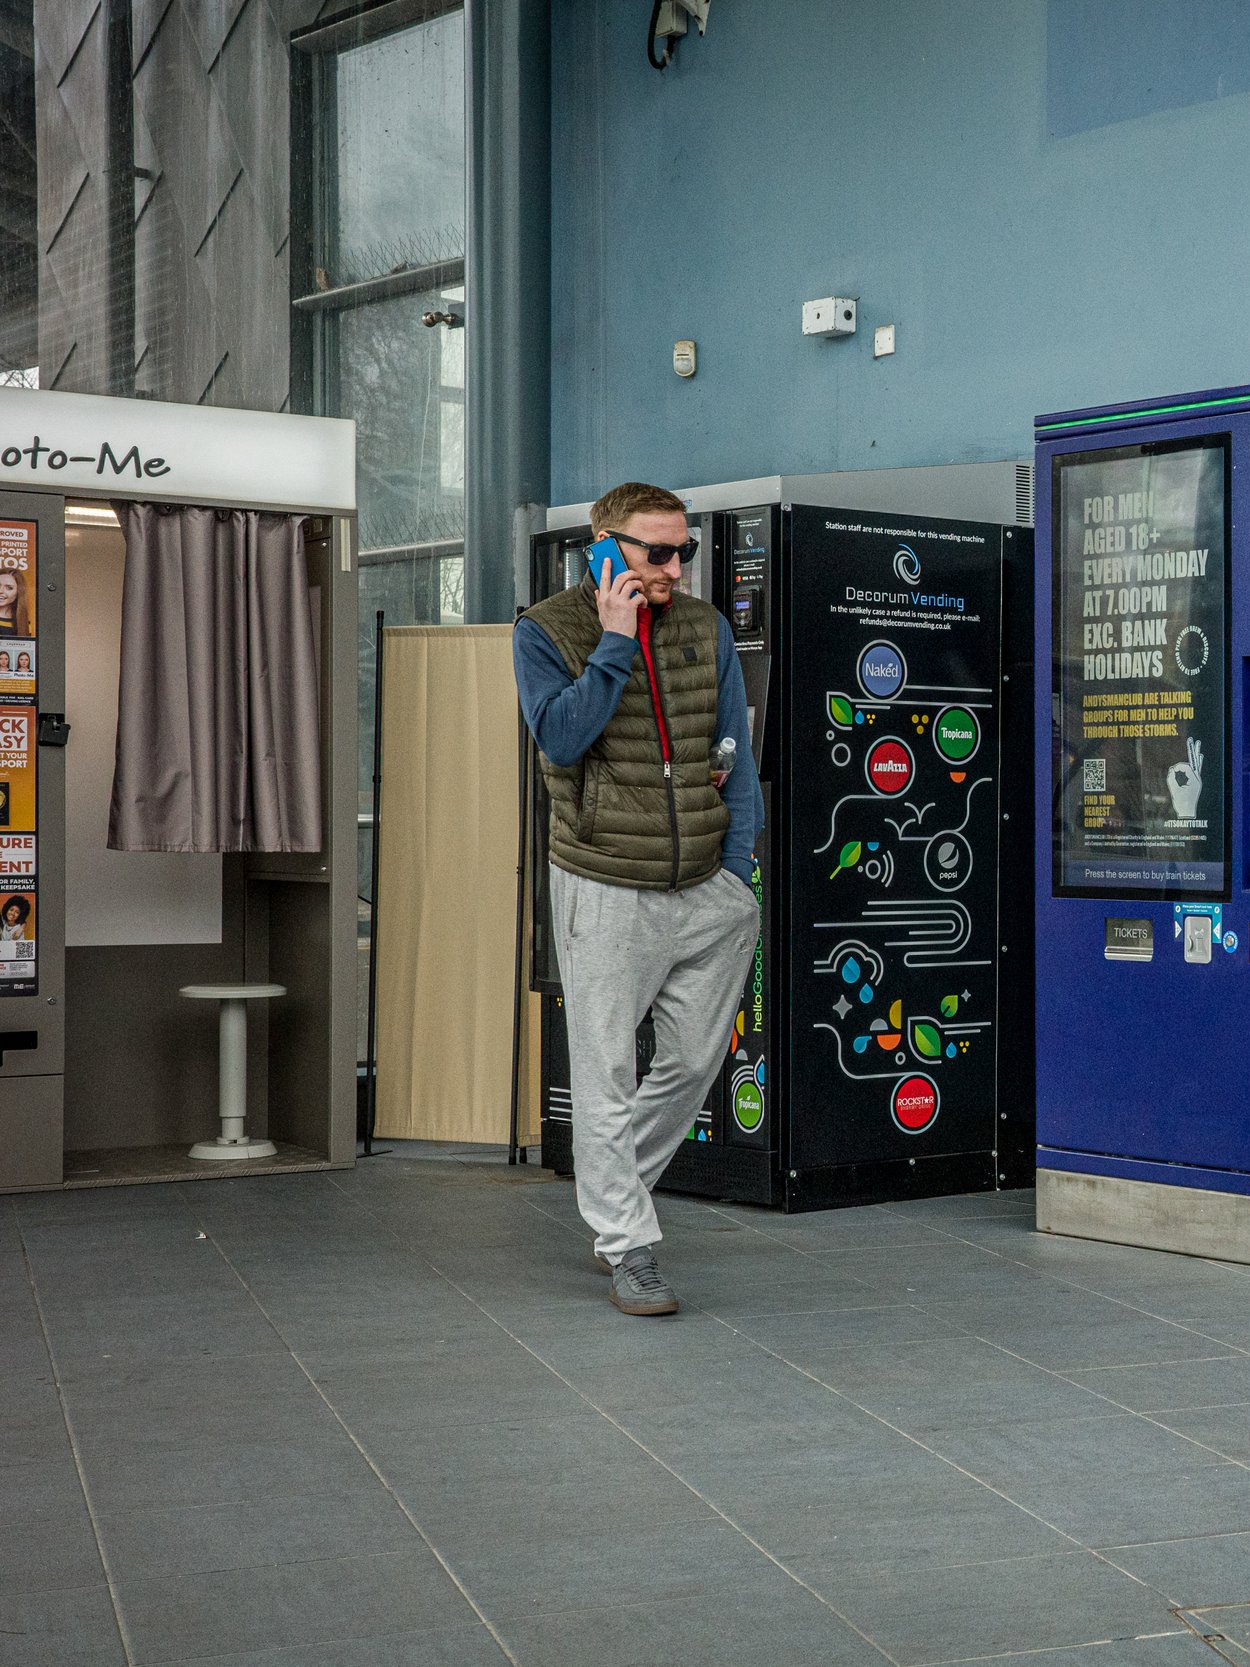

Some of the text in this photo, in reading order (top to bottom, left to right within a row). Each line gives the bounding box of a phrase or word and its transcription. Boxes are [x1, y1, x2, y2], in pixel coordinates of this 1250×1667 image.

[1084, 491, 1154, 524] FOR MEN
[825, 521, 985, 543] Station staff are not responsible for this vending machine
[1084, 523, 1160, 554] AGED 18+
[0, 548, 28, 557] PORT
[1084, 549, 1208, 585] EVERY MONDAY
[846, 586, 965, 612] Decorum Vending
[1083, 585, 1167, 617] AT 7.00PM
[838, 605, 848, 613] the
[848, 606, 872, 616] unlikely
[872, 608, 886, 616] case
[891, 608, 911, 618] refund
[911, 610, 917, 618] is
[917, 610, 943, 621] required,
[943, 612, 961, 622] please
[961, 614, 980, 623] e-mail:
[859, 617, 951, 630] refunds@decorumvending.co.uk
[1084, 618, 1167, 649] EXC. BANK
[1084, 650, 1163, 680] HOLIDAYS
[1083, 690, 1192, 707] ANDYSMANCLUB ARE TALKING
[1083, 707, 1194, 723] GROUPS FOR MEN TO HELP YOU
[941, 727, 972, 740] Tropicana
[1083, 723, 1179, 738] THROUGH THOSE STORMS.
[0, 736, 25, 749] SY
[873, 760, 907, 773] LAVAZZA
[1084, 795, 1116, 805] FIND YOUR
[1084, 806, 1110, 816] NEAREST
[1084, 818, 1105, 828] GROUP
[939, 870, 958, 880] pepsi
[1085, 868, 1206, 882] Press the screen to buy train tickets
[1114, 927, 1148, 939] TICKETS
